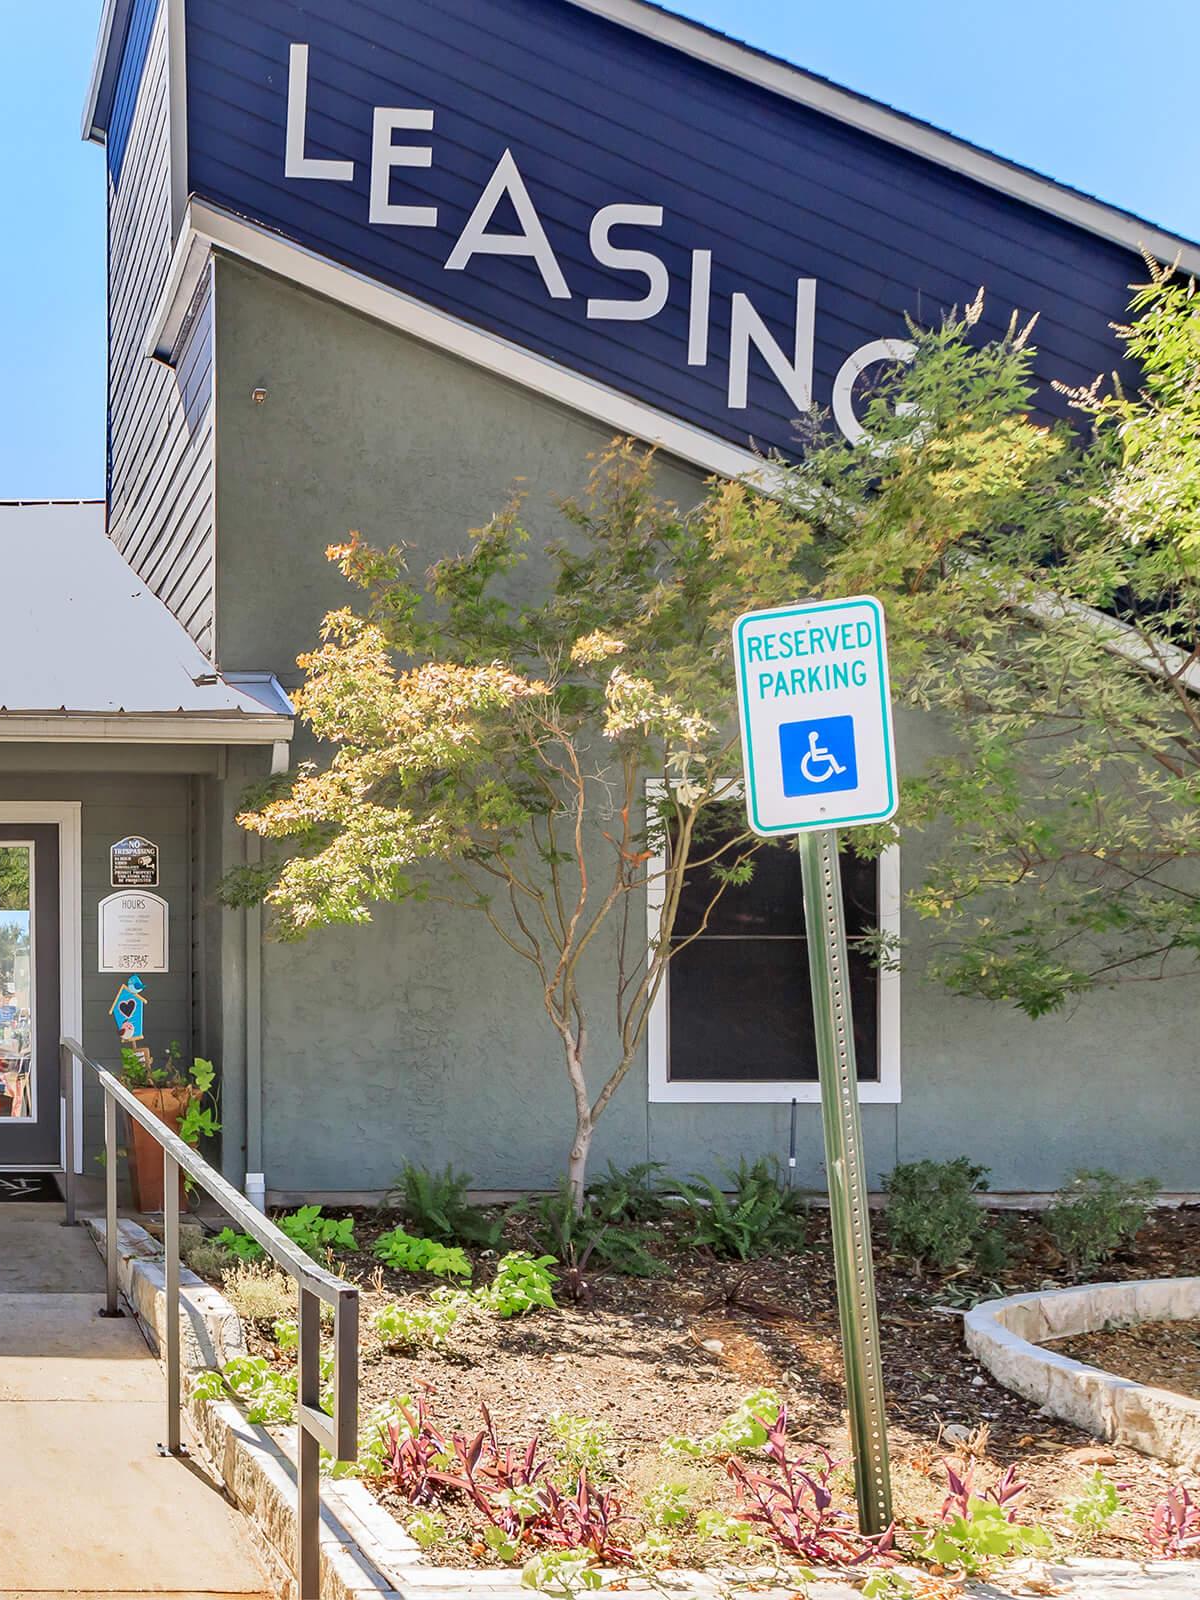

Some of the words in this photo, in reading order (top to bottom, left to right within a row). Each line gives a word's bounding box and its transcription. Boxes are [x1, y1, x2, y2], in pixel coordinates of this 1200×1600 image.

[285, 43, 932, 458] LEASING
[747, 621, 872, 663] RESERVED
[759, 660, 867, 699] PARKING
[129, 840, 140, 848] NO
[122, 900, 145, 909] HOURS
